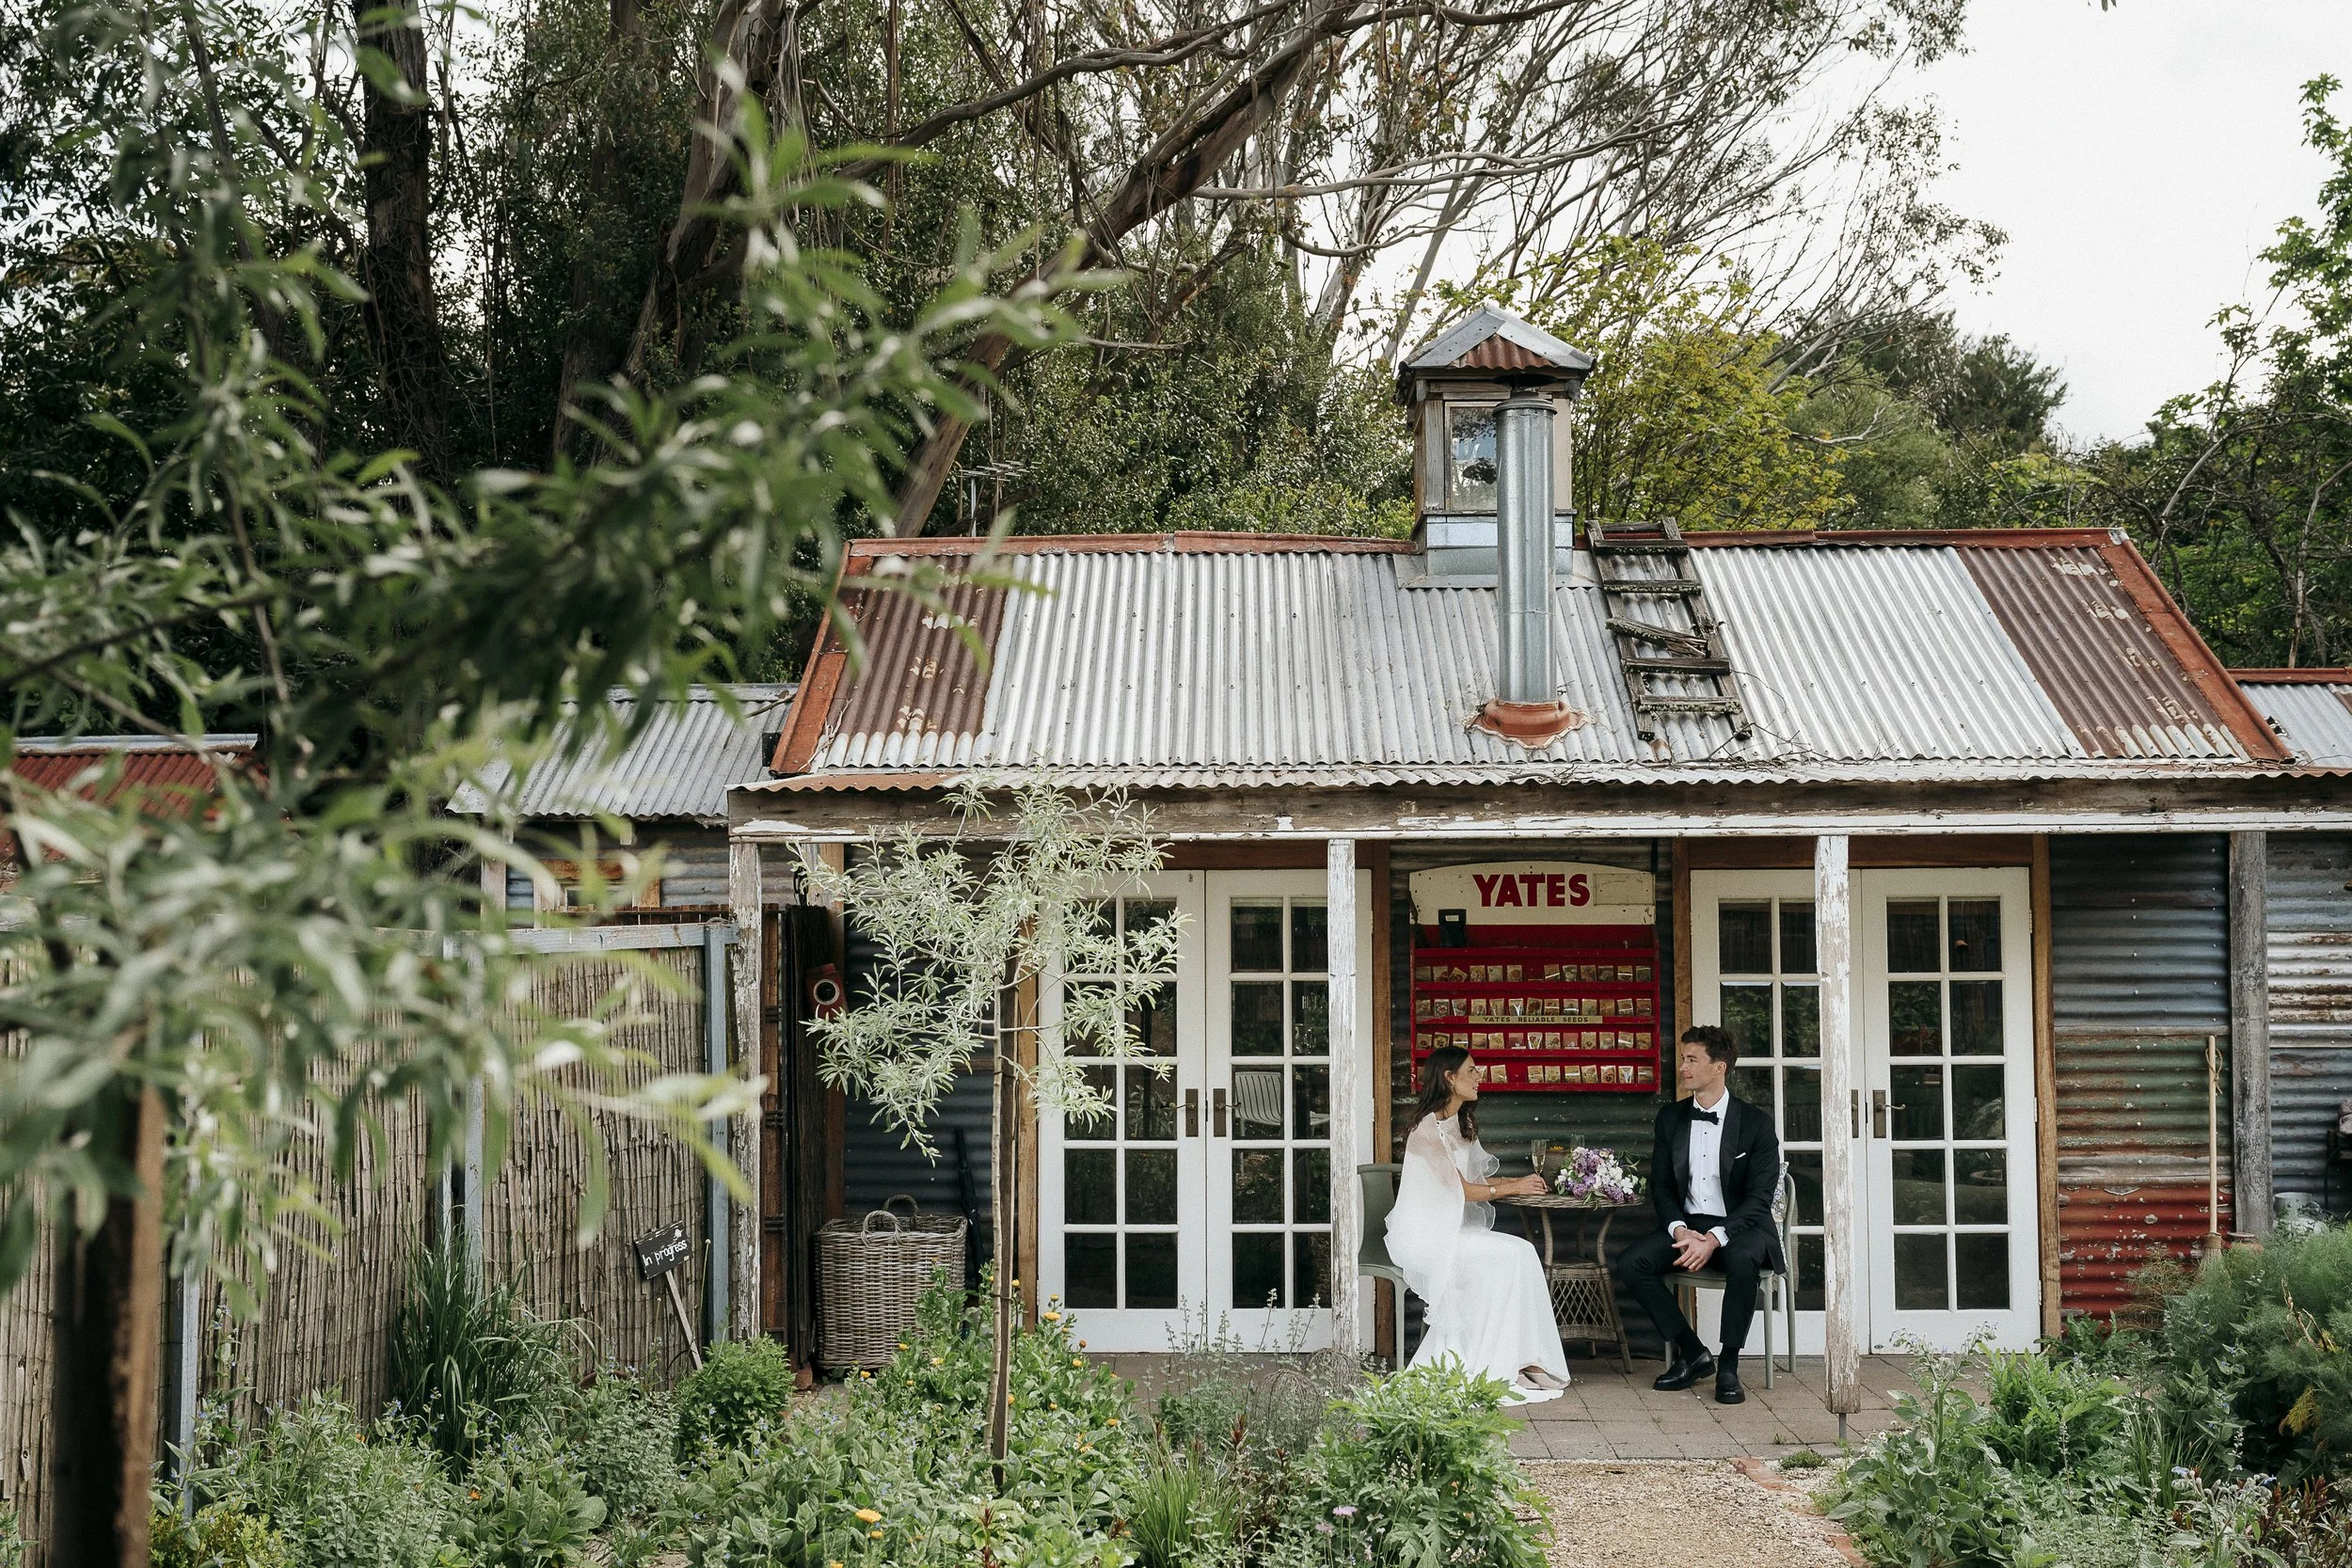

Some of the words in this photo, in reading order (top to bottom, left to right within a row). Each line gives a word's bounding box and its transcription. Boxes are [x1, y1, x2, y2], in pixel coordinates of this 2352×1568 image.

[1472, 873, 1591, 908] YATES
[642, 1254, 653, 1267] In
[654, 1240, 688, 1266] progress
